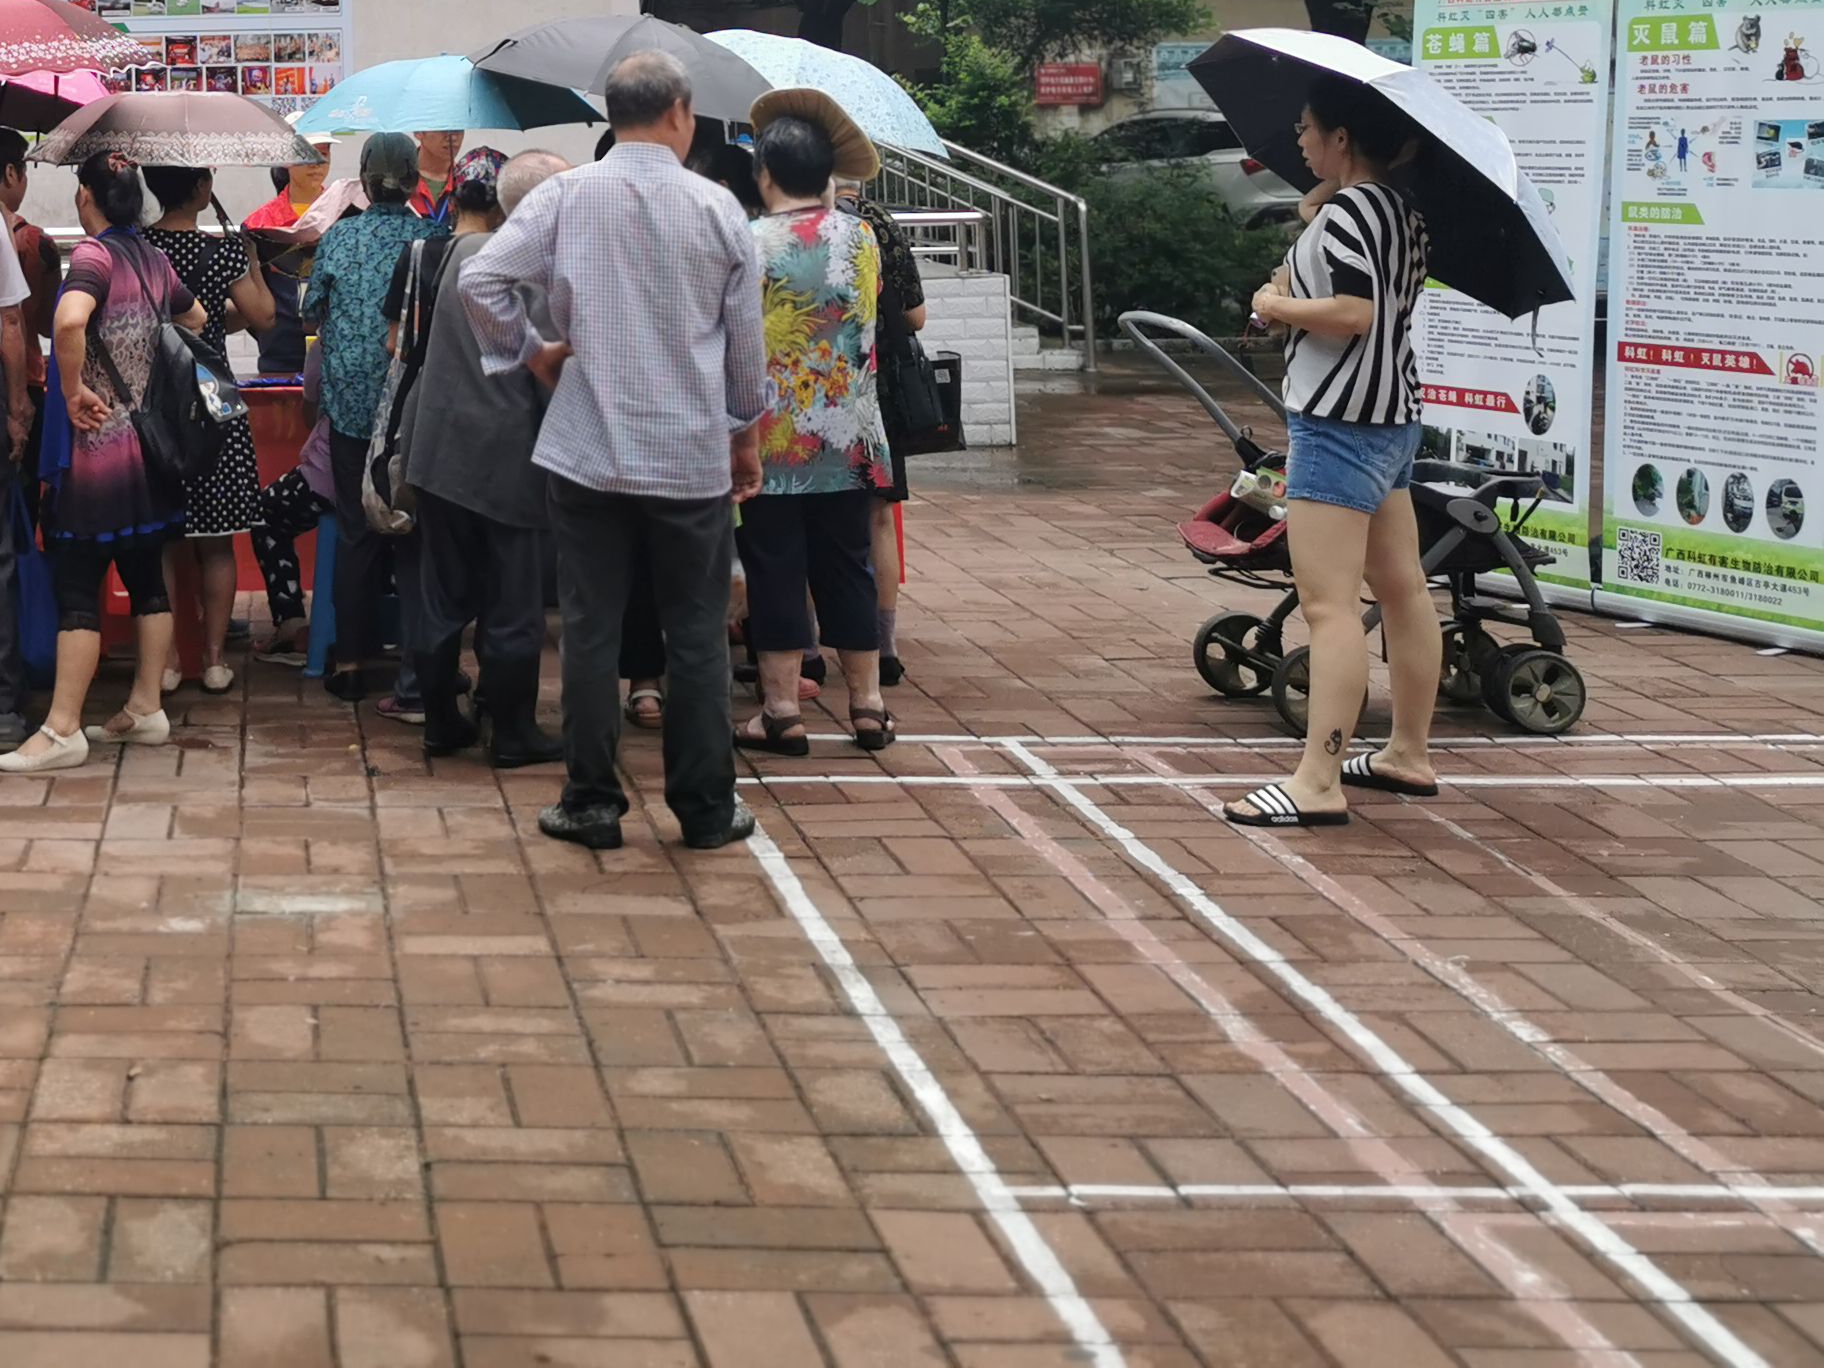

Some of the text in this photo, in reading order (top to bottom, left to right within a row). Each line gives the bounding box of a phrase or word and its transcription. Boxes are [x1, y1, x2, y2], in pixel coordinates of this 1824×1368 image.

[1632, 21, 1709, 45] 灭鼠篇
[1426, 32, 1490, 54] 苍蝇篇
[1639, 54, 1692, 65] 老鼠的习性
[1637, 83, 1690, 94] 老鼠的危害
[1628, 206, 1682, 219] 鼠类的防治
[1665, 548, 1819, 583] 广西科虹有害生物防治有限公司
